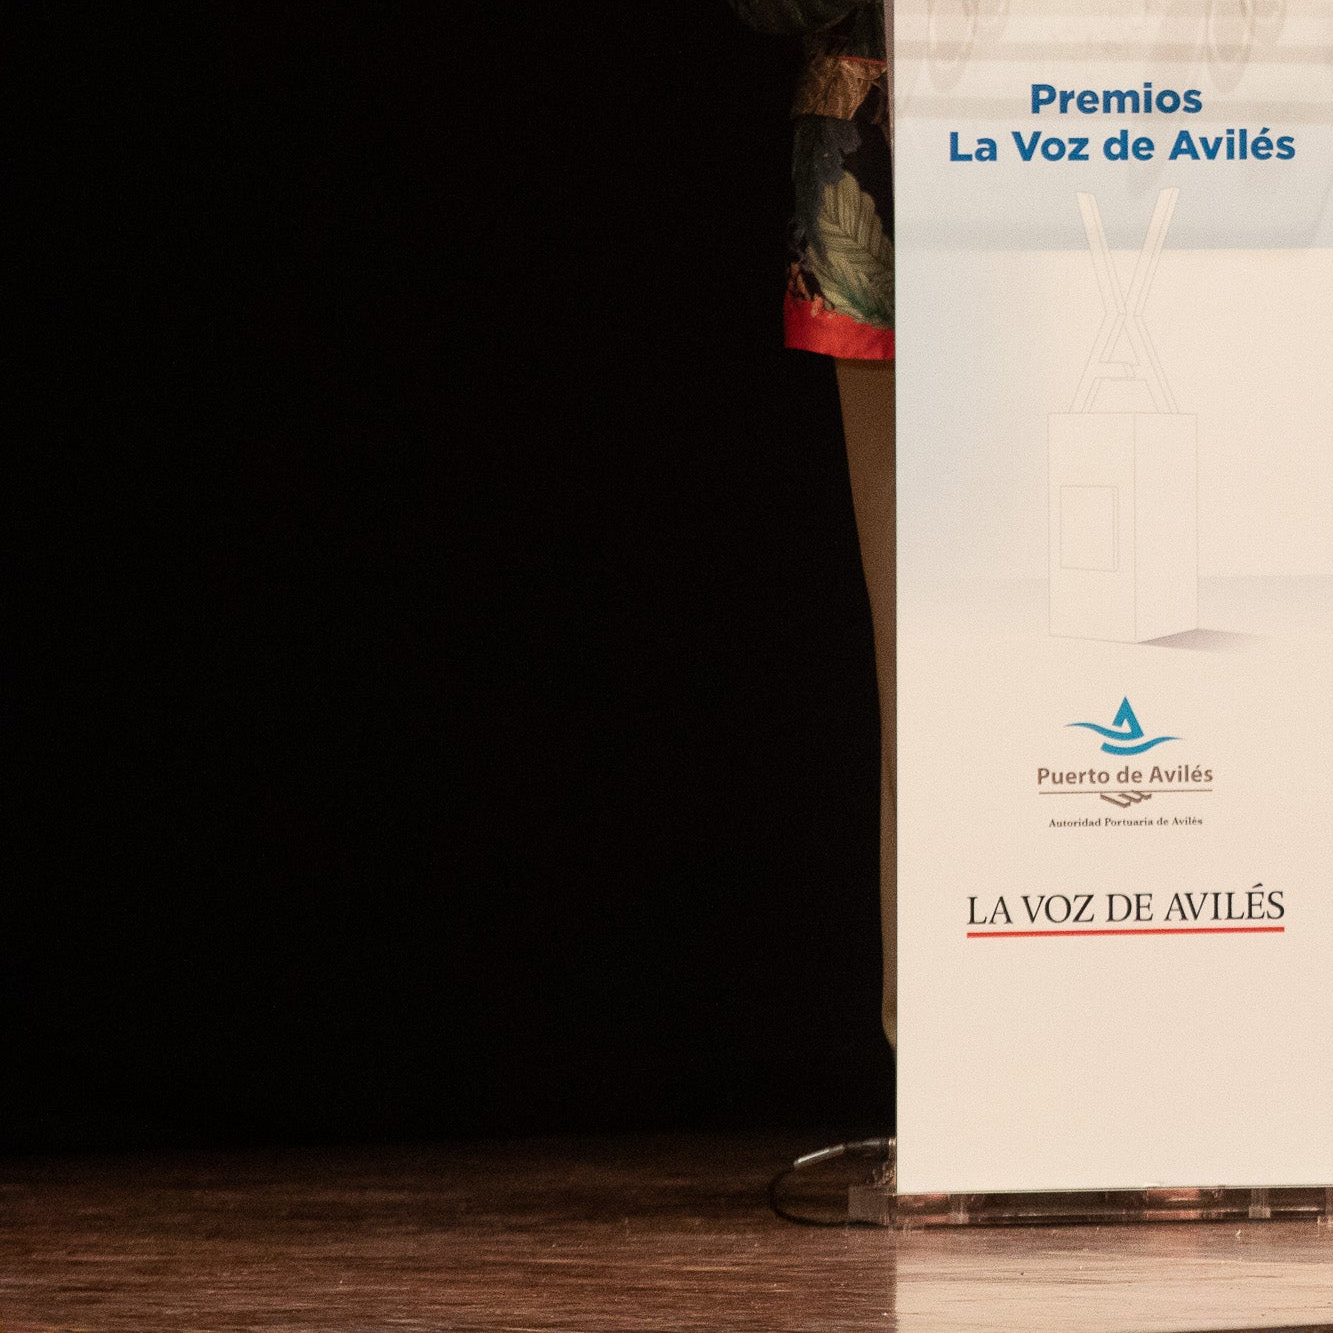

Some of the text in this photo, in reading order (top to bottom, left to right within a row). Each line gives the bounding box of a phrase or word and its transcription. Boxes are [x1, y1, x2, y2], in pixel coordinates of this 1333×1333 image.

[1031, 82, 1203, 114] Premios
[949, 127, 1296, 162] La Voz de Avilés
[1037, 764, 1214, 785] Puerto de Avilés
[1049, 816, 1203, 828] Autoridad Portuaria de Avilés
[966, 882, 1286, 925] LA VOZ DE AVILÉS
